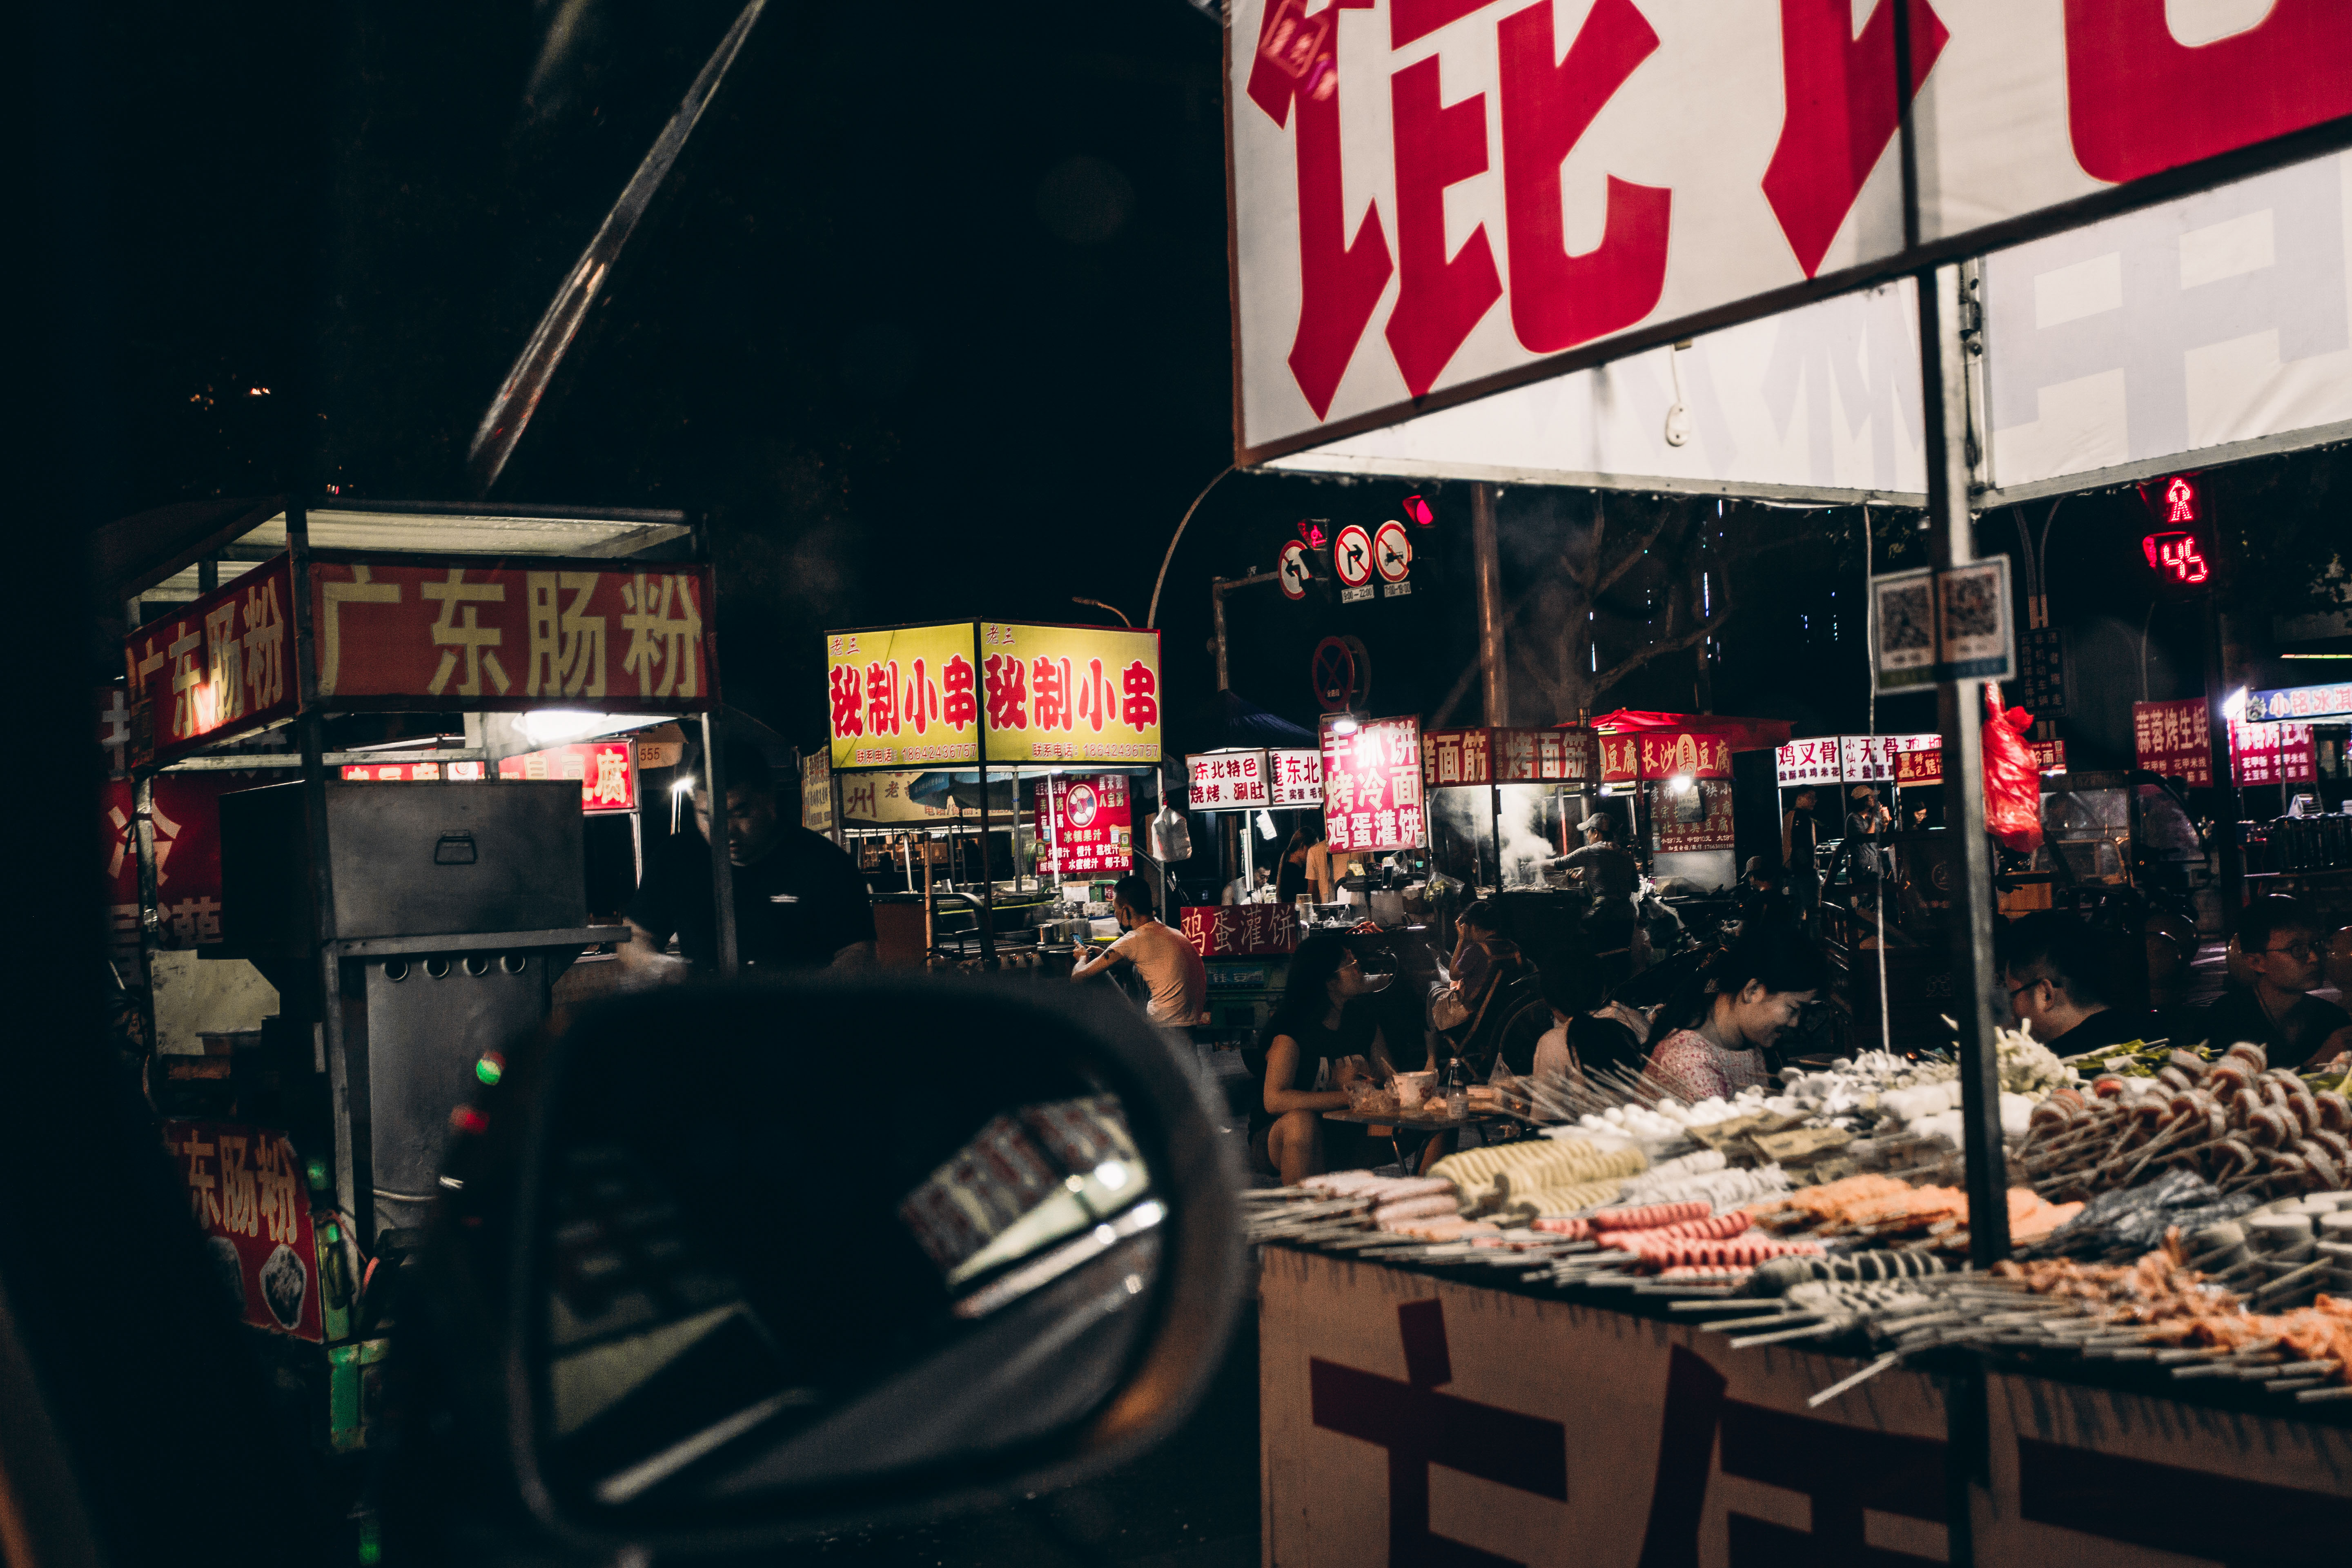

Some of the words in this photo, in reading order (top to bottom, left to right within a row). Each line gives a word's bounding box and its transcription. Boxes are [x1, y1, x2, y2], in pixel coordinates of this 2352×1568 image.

[2161, 537, 2208, 583] 45
[318, 564, 702, 699] 广东肠粉
[830, 636, 860, 656] 老三
[986, 624, 1015, 645] 老三
[138, 576, 284, 738] 广东肠粉
[829, 653, 977, 740] 秘制小串
[983, 652, 1158, 734] 秘制小串
[640, 747, 660, 761] 555
[1323, 720, 1418, 771] 手抓饼
[1506, 731, 1588, 779] 烤面筋
[1642, 736, 1729, 774] 长沙臭豆腐
[1778, 740, 1838, 766] 鸡叉骨
[1845, 738, 1856, 777] 小仙女
[1195, 758, 1257, 780] 东北特色
[1286, 756, 1319, 784] 东北
[1325, 765, 1419, 813] 烤冷面
[1064, 829, 1102, 843] 冰镇果汁
[1327, 808, 1421, 849] 鸡蛋灌饼
[1068, 858, 1099, 870] 水蜜桃汁
[1105, 856, 1129, 868] 椰子奶
[1076, 845, 1091, 857] 橙汁
[1181, 904, 1296, 954] 鸡蛋灌饼
[163, 1129, 297, 1244] 东肠粉
